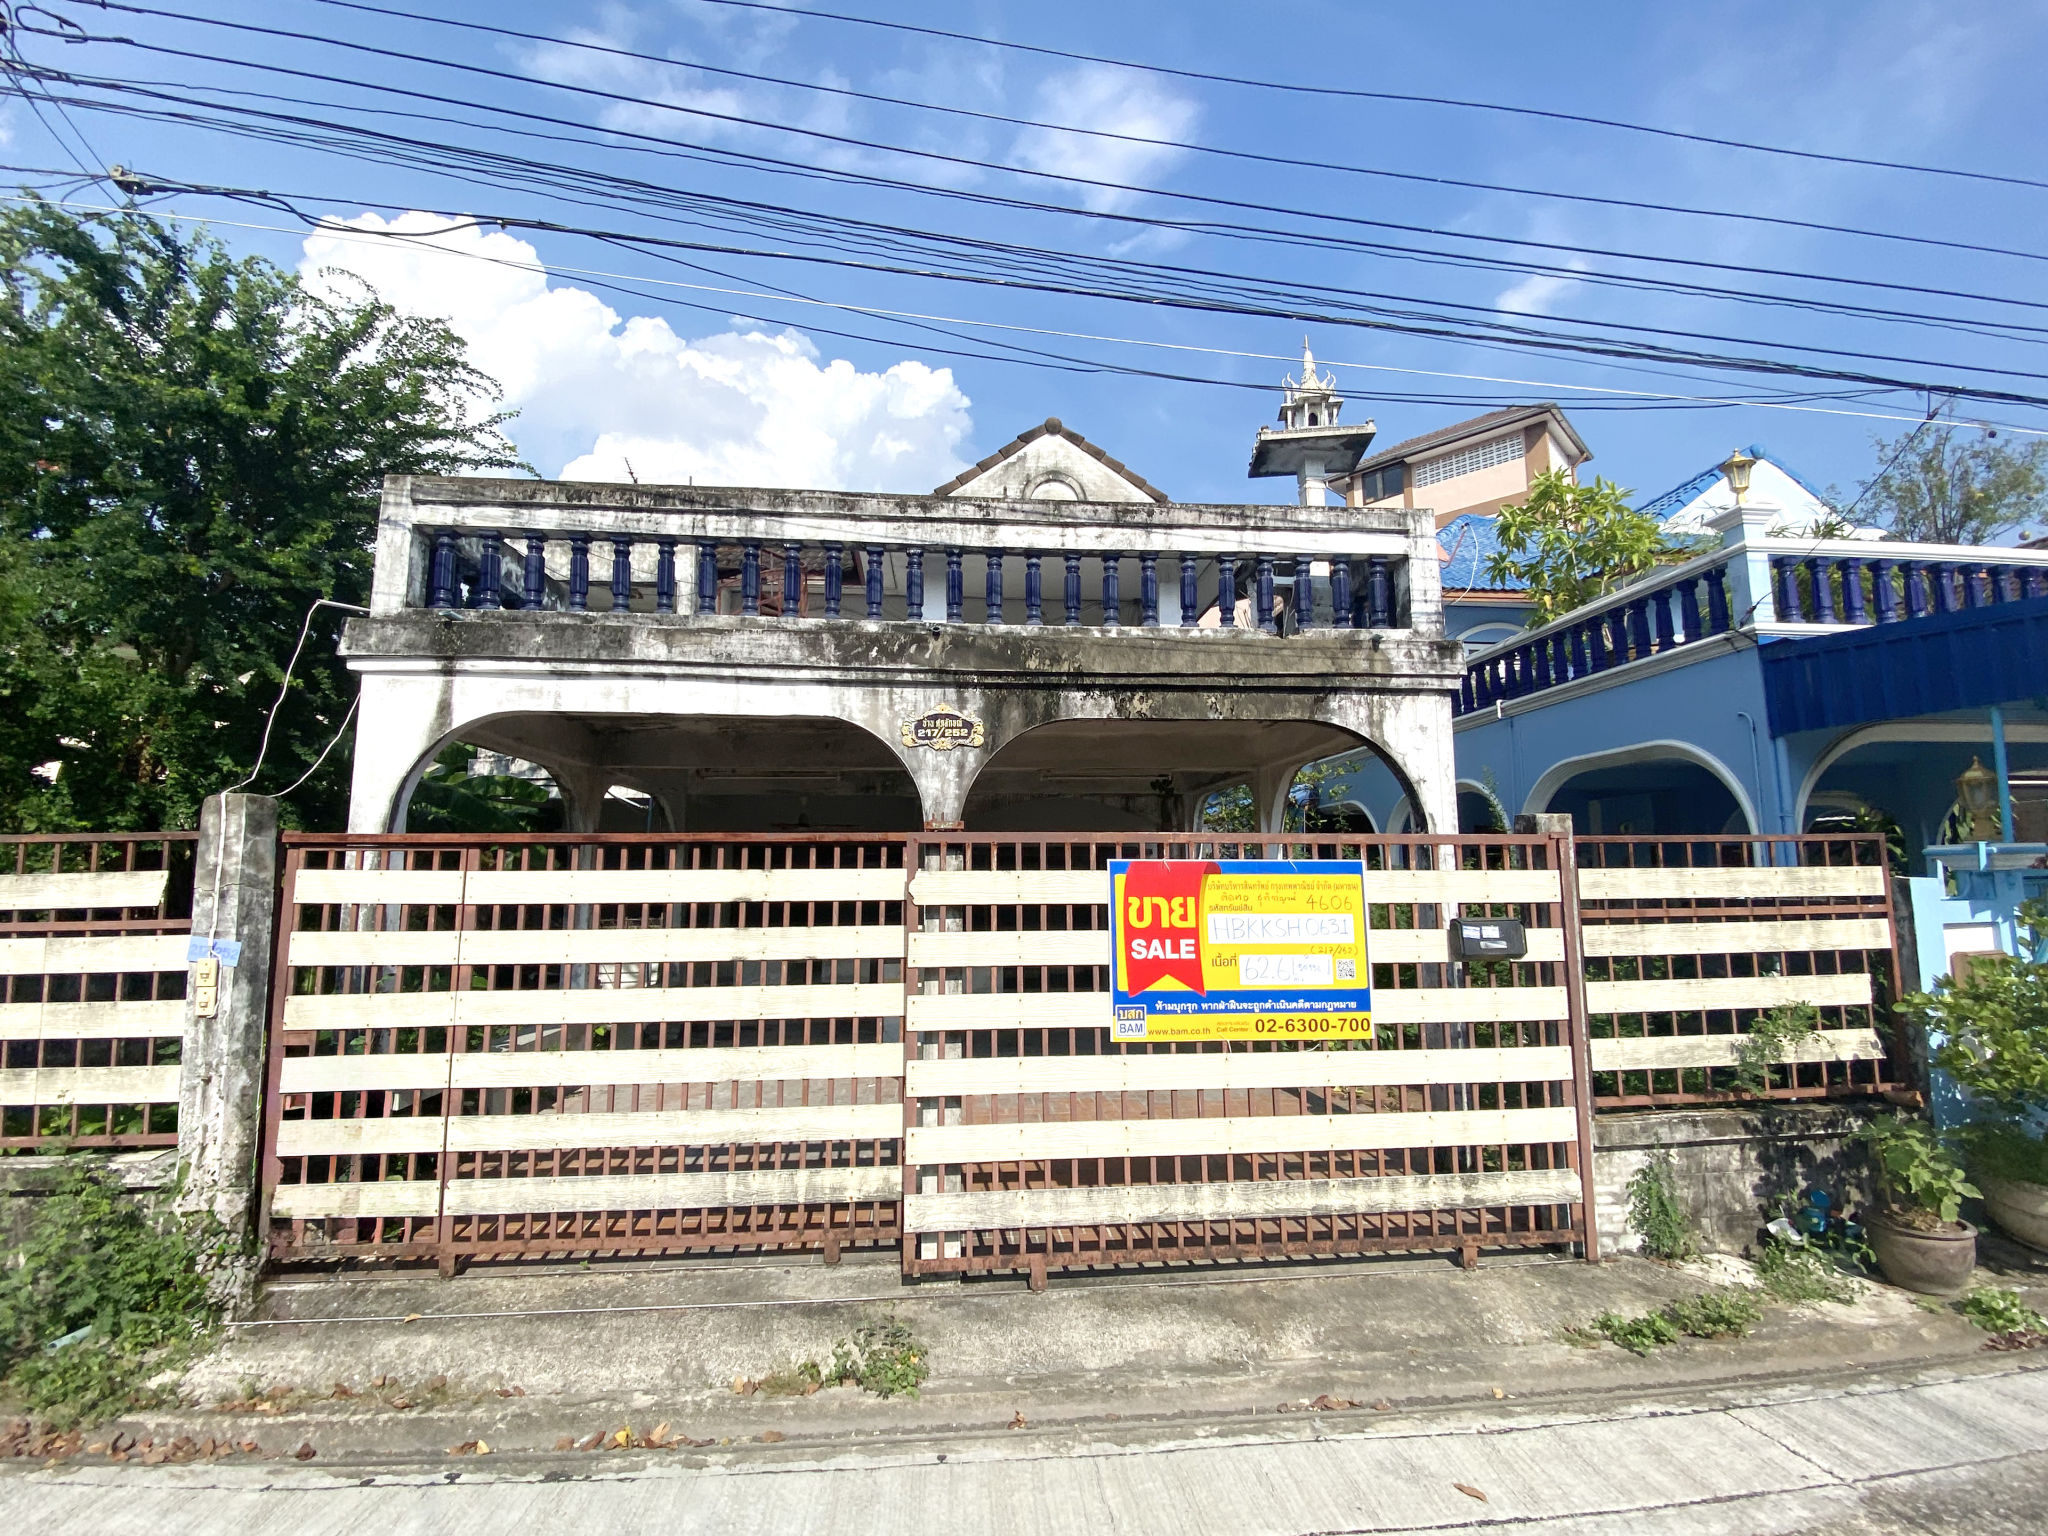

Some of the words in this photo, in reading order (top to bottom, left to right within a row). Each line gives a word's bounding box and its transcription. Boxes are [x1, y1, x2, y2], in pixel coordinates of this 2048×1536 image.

[917, 727, 969, 739] 217/252
[1305, 894, 1353, 911] 4606
[1128, 896, 1197, 929] ขาย
[1131, 938, 1196, 960] SALE
[1211, 953, 1237, 968] เนื้อที่
[1155, 1000, 1198, 1014] ห้ามบุกรุก
[1118, 1009, 1144, 1020] บสก
[1119, 1023, 1144, 1034] BAM
[1147, 1027, 1211, 1036] www.bam.co.th
[1254, 1017, 1371, 1033] 02-6300-700
